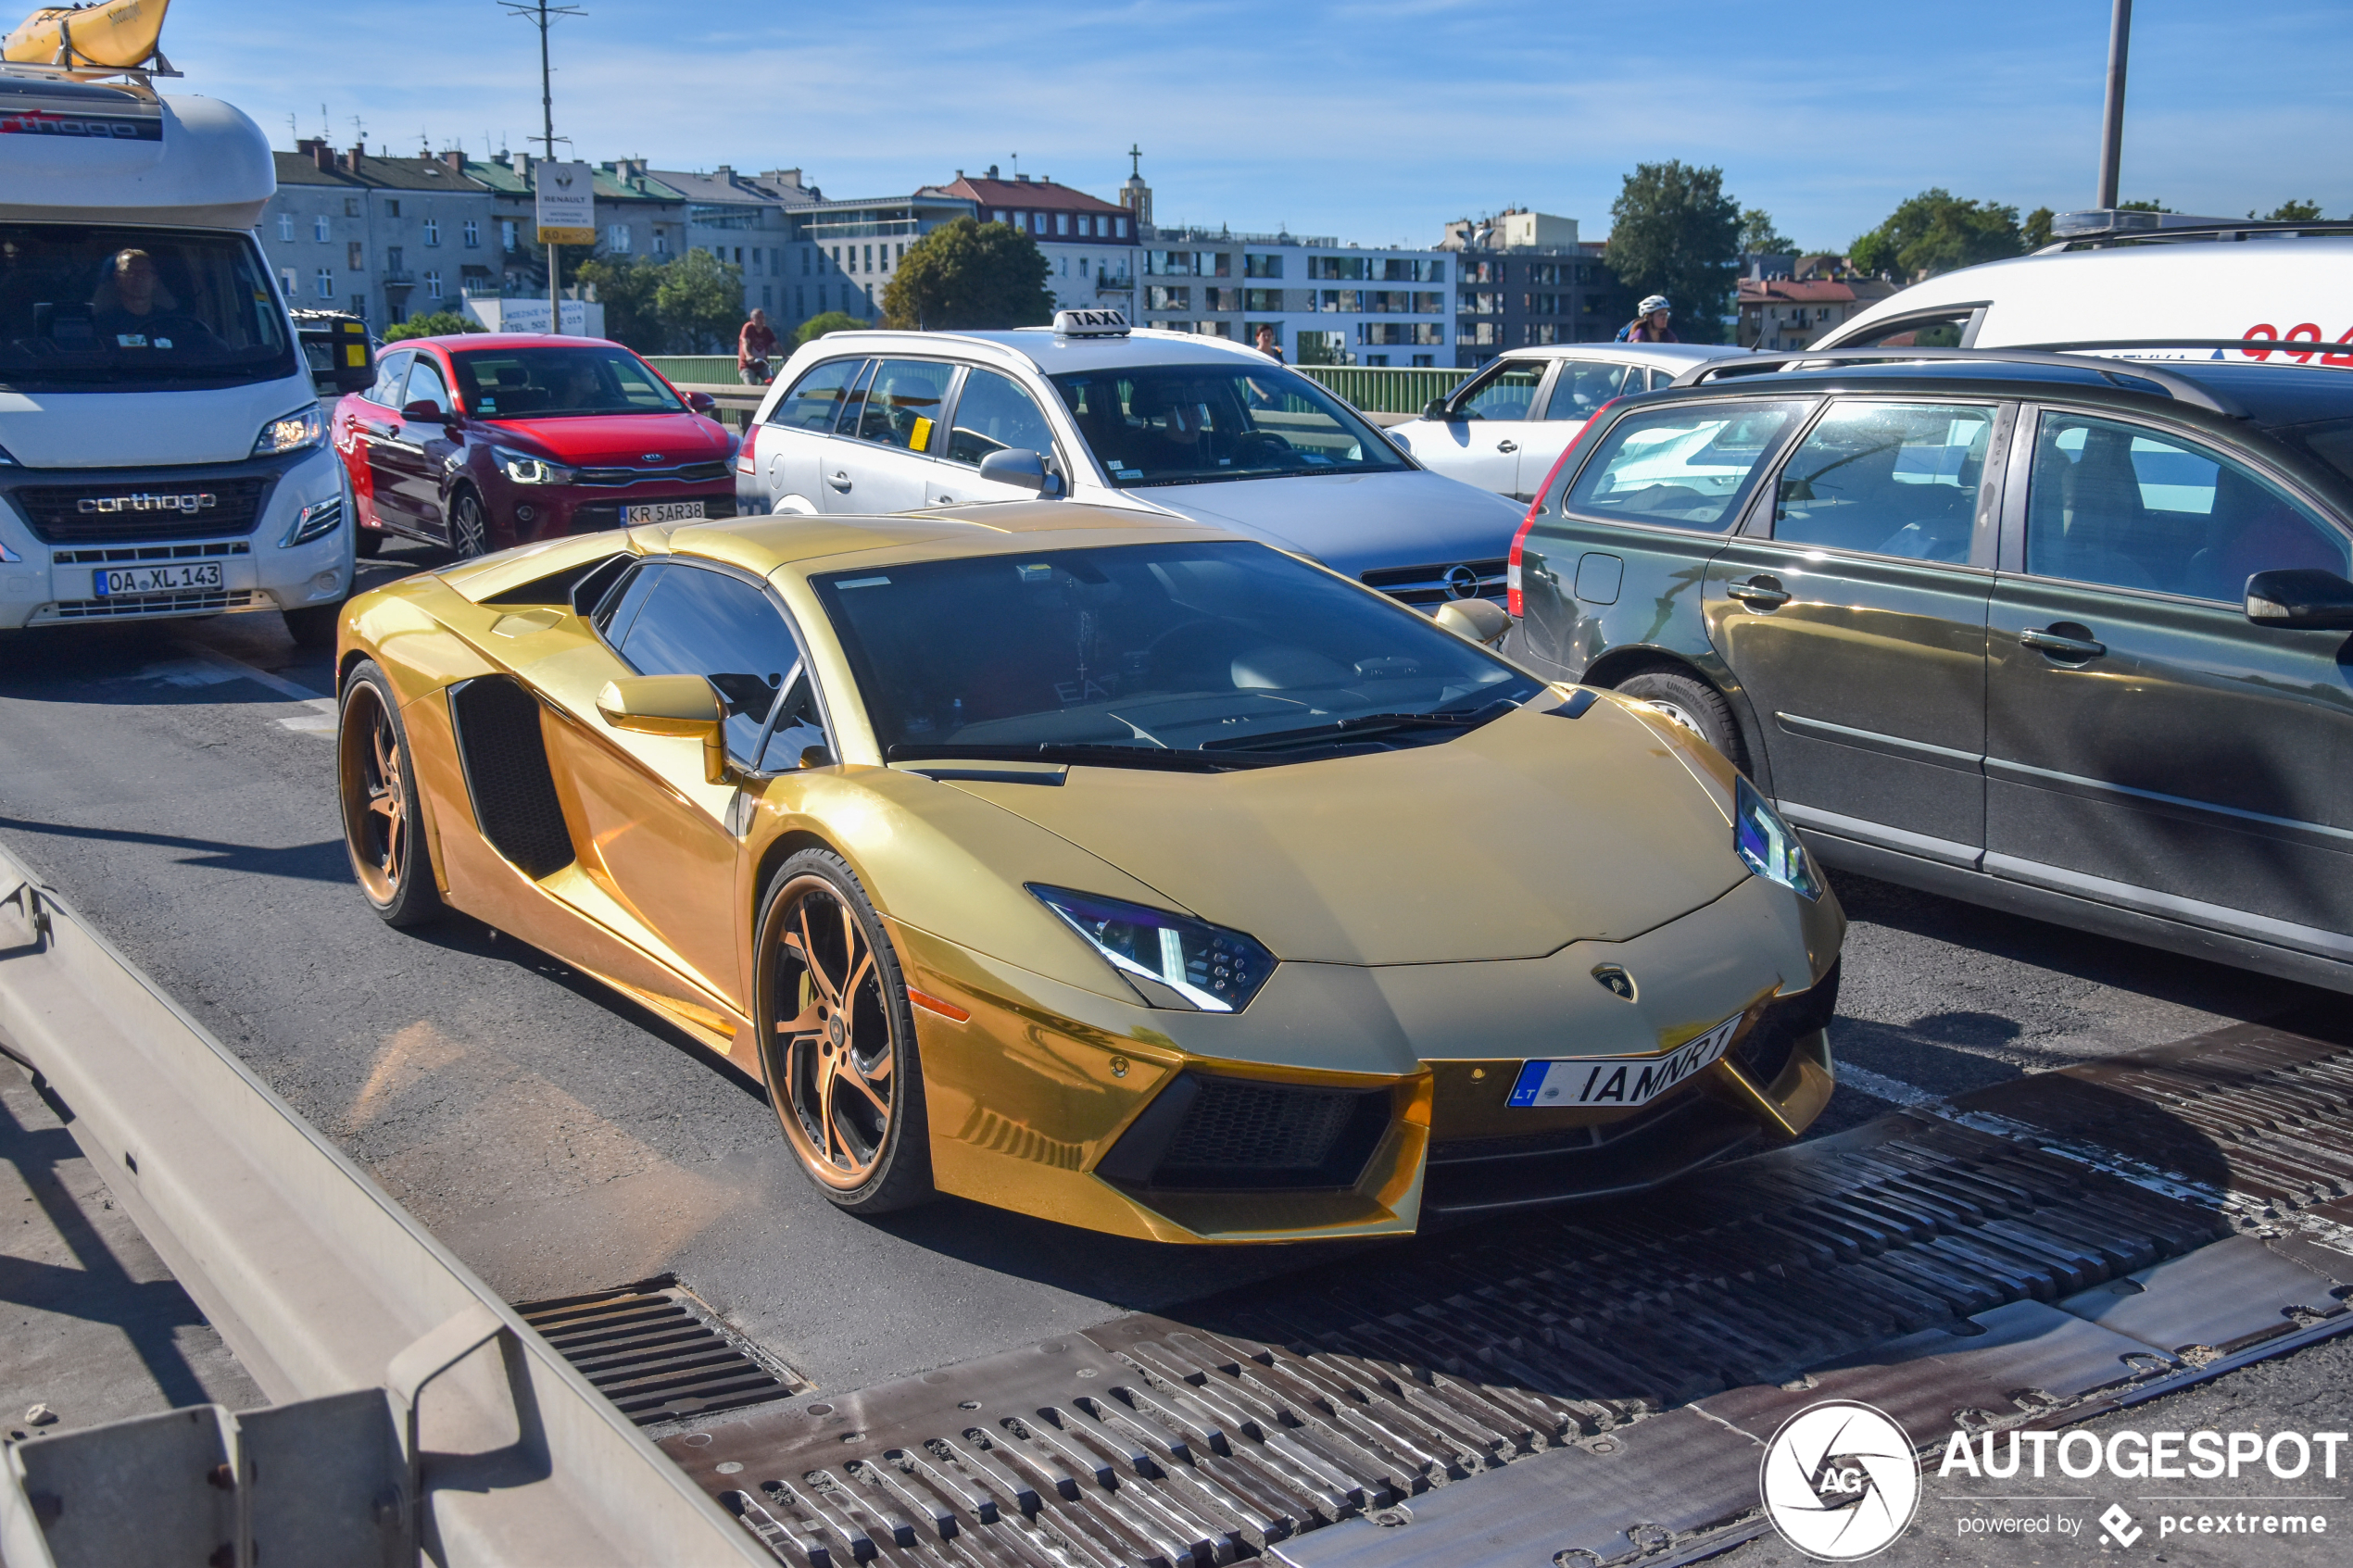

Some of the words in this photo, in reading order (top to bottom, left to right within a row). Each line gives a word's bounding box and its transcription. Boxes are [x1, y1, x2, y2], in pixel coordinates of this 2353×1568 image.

[1065, 311, 1126, 326] TAXI
[77, 493, 218, 514] carthago
[629, 507, 650, 522] KR
[657, 503, 702, 521] 5AR38
[108, 571, 137, 592] OA
[150, 570, 177, 588] XL
[182, 566, 219, 586] 143
[1514, 1089, 1536, 1100] LT
